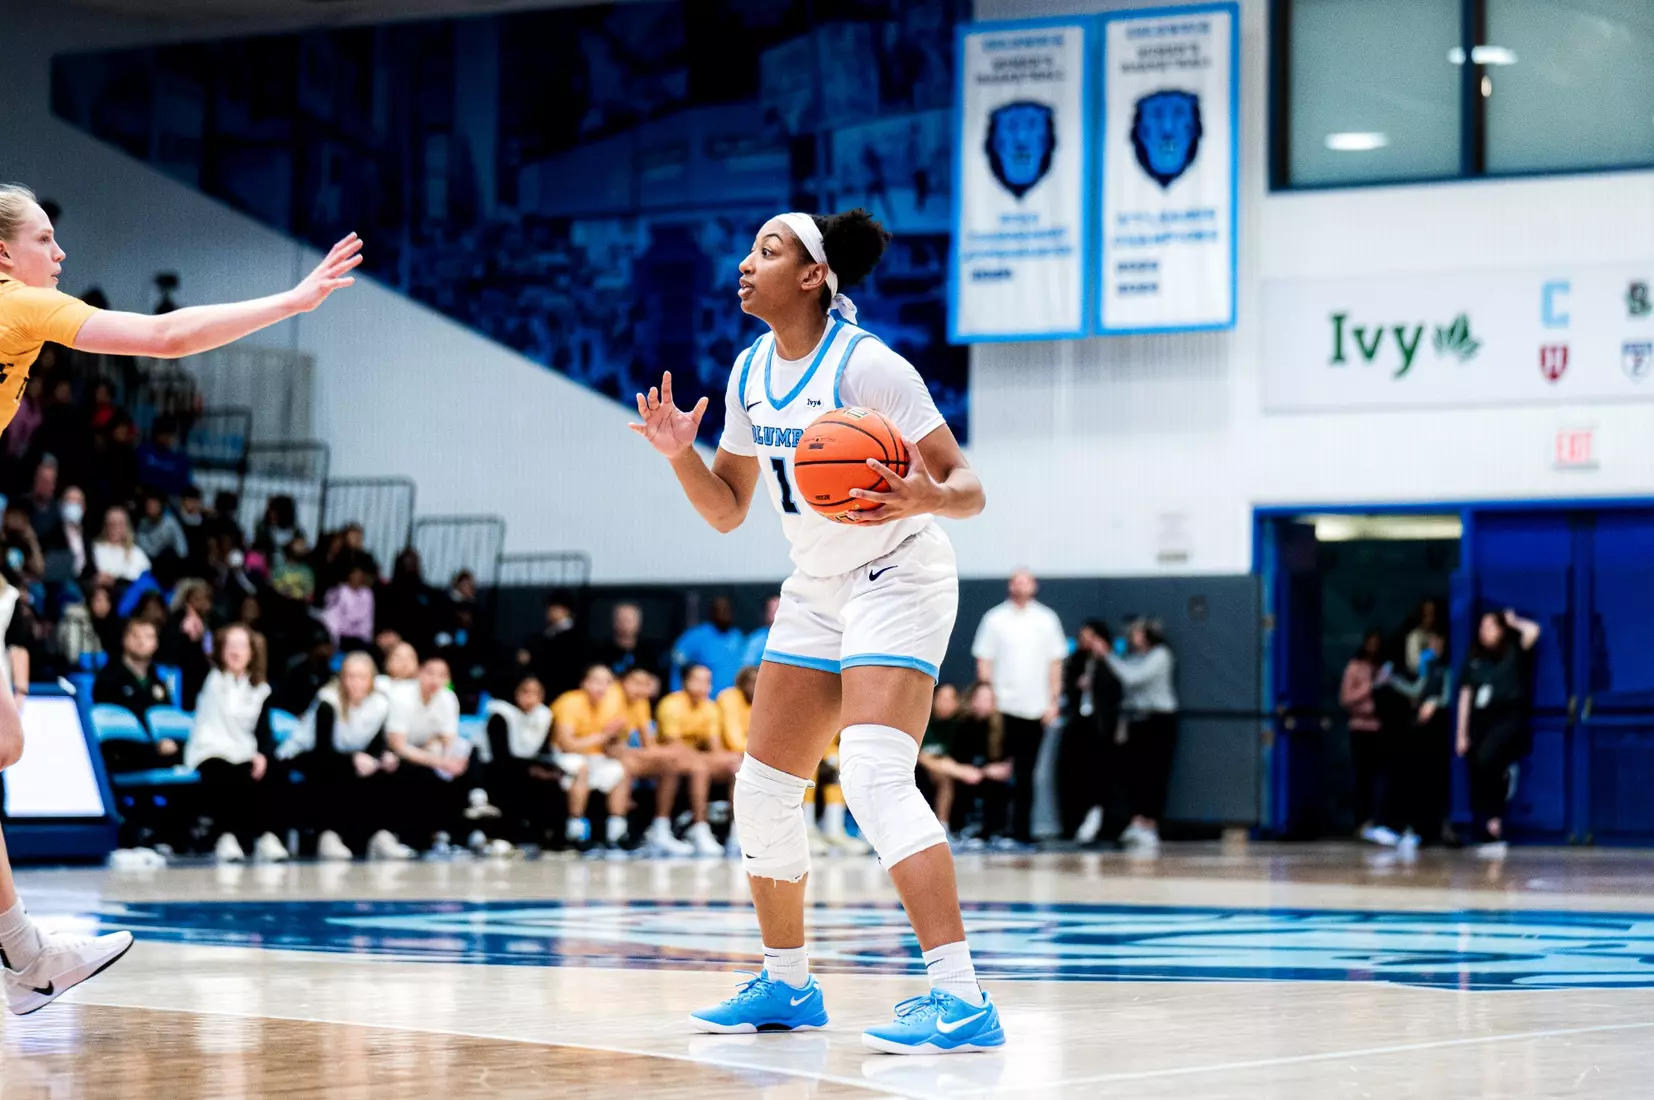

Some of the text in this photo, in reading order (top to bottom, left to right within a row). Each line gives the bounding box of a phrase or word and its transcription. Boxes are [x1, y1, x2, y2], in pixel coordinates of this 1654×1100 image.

[1329, 312, 1424, 380] Ivy
[807, 399, 817, 408] Ivy
[770, 457, 801, 515] 1
